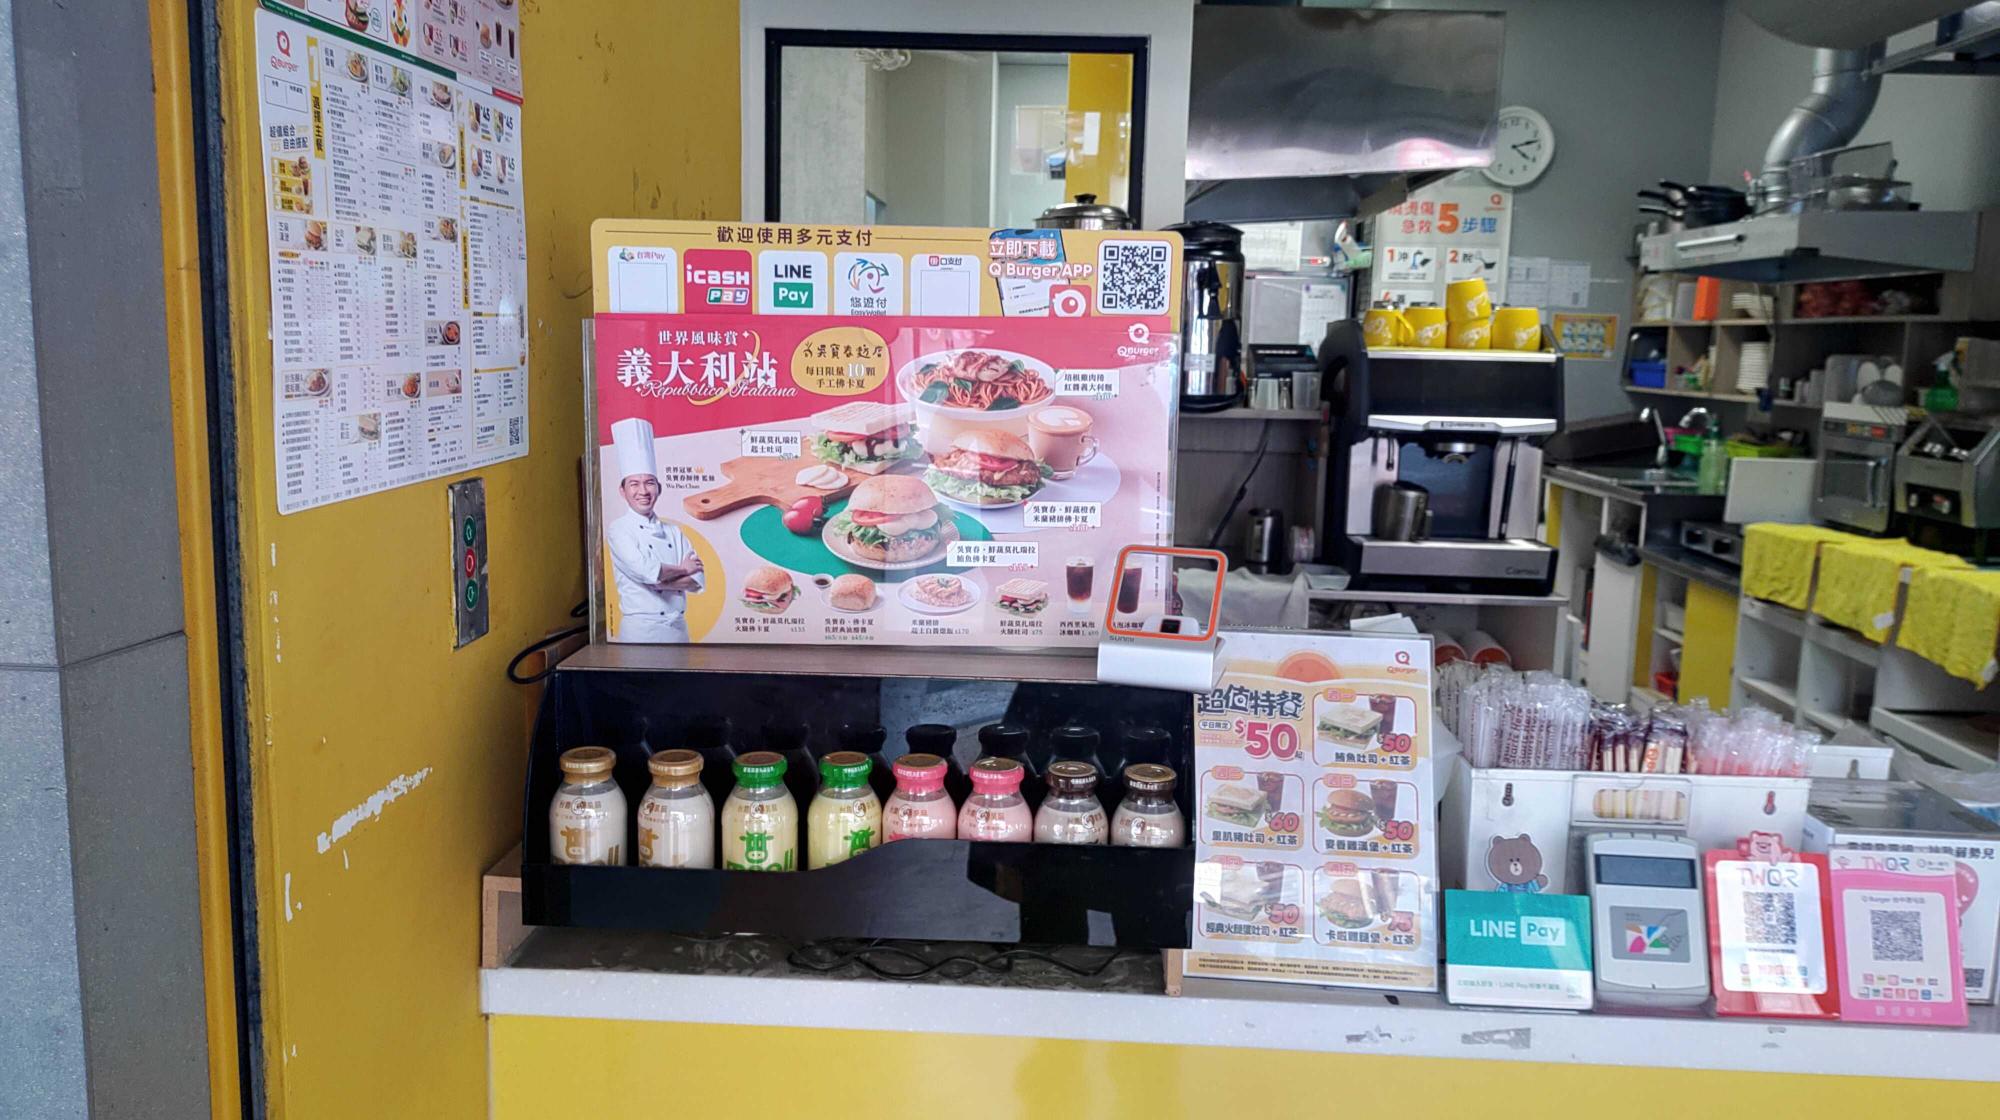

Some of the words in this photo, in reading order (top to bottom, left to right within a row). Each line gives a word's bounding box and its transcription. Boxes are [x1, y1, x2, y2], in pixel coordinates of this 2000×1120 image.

[1438, 203, 1459, 234] 5
[717, 227, 873, 247] 歡迎使用多元支付
[989, 239, 1056, 257] 立即下載
[1449, 250, 1458, 263] 2
[774, 264, 813, 279] LINE
[989, 262, 1002, 277] Q
[1006, 263, 1057, 279] Burger
[1062, 264, 1092, 278] APP
[778, 287, 809, 304] Pay
[850, 297, 888, 309] 悠遊付
[658, 330, 739, 347] 世界風味賞
[616, 347, 778, 389] 義大利站
[640, 380, 725, 399] Repubblica
[729, 379, 799, 399] Italiana
[817, 378, 865, 389] 手工佛卡夏
[1197, 684, 1304, 720] 超值特餐
[1469, 919, 1516, 938] LINE
[1526, 922, 1560, 942] Pay
